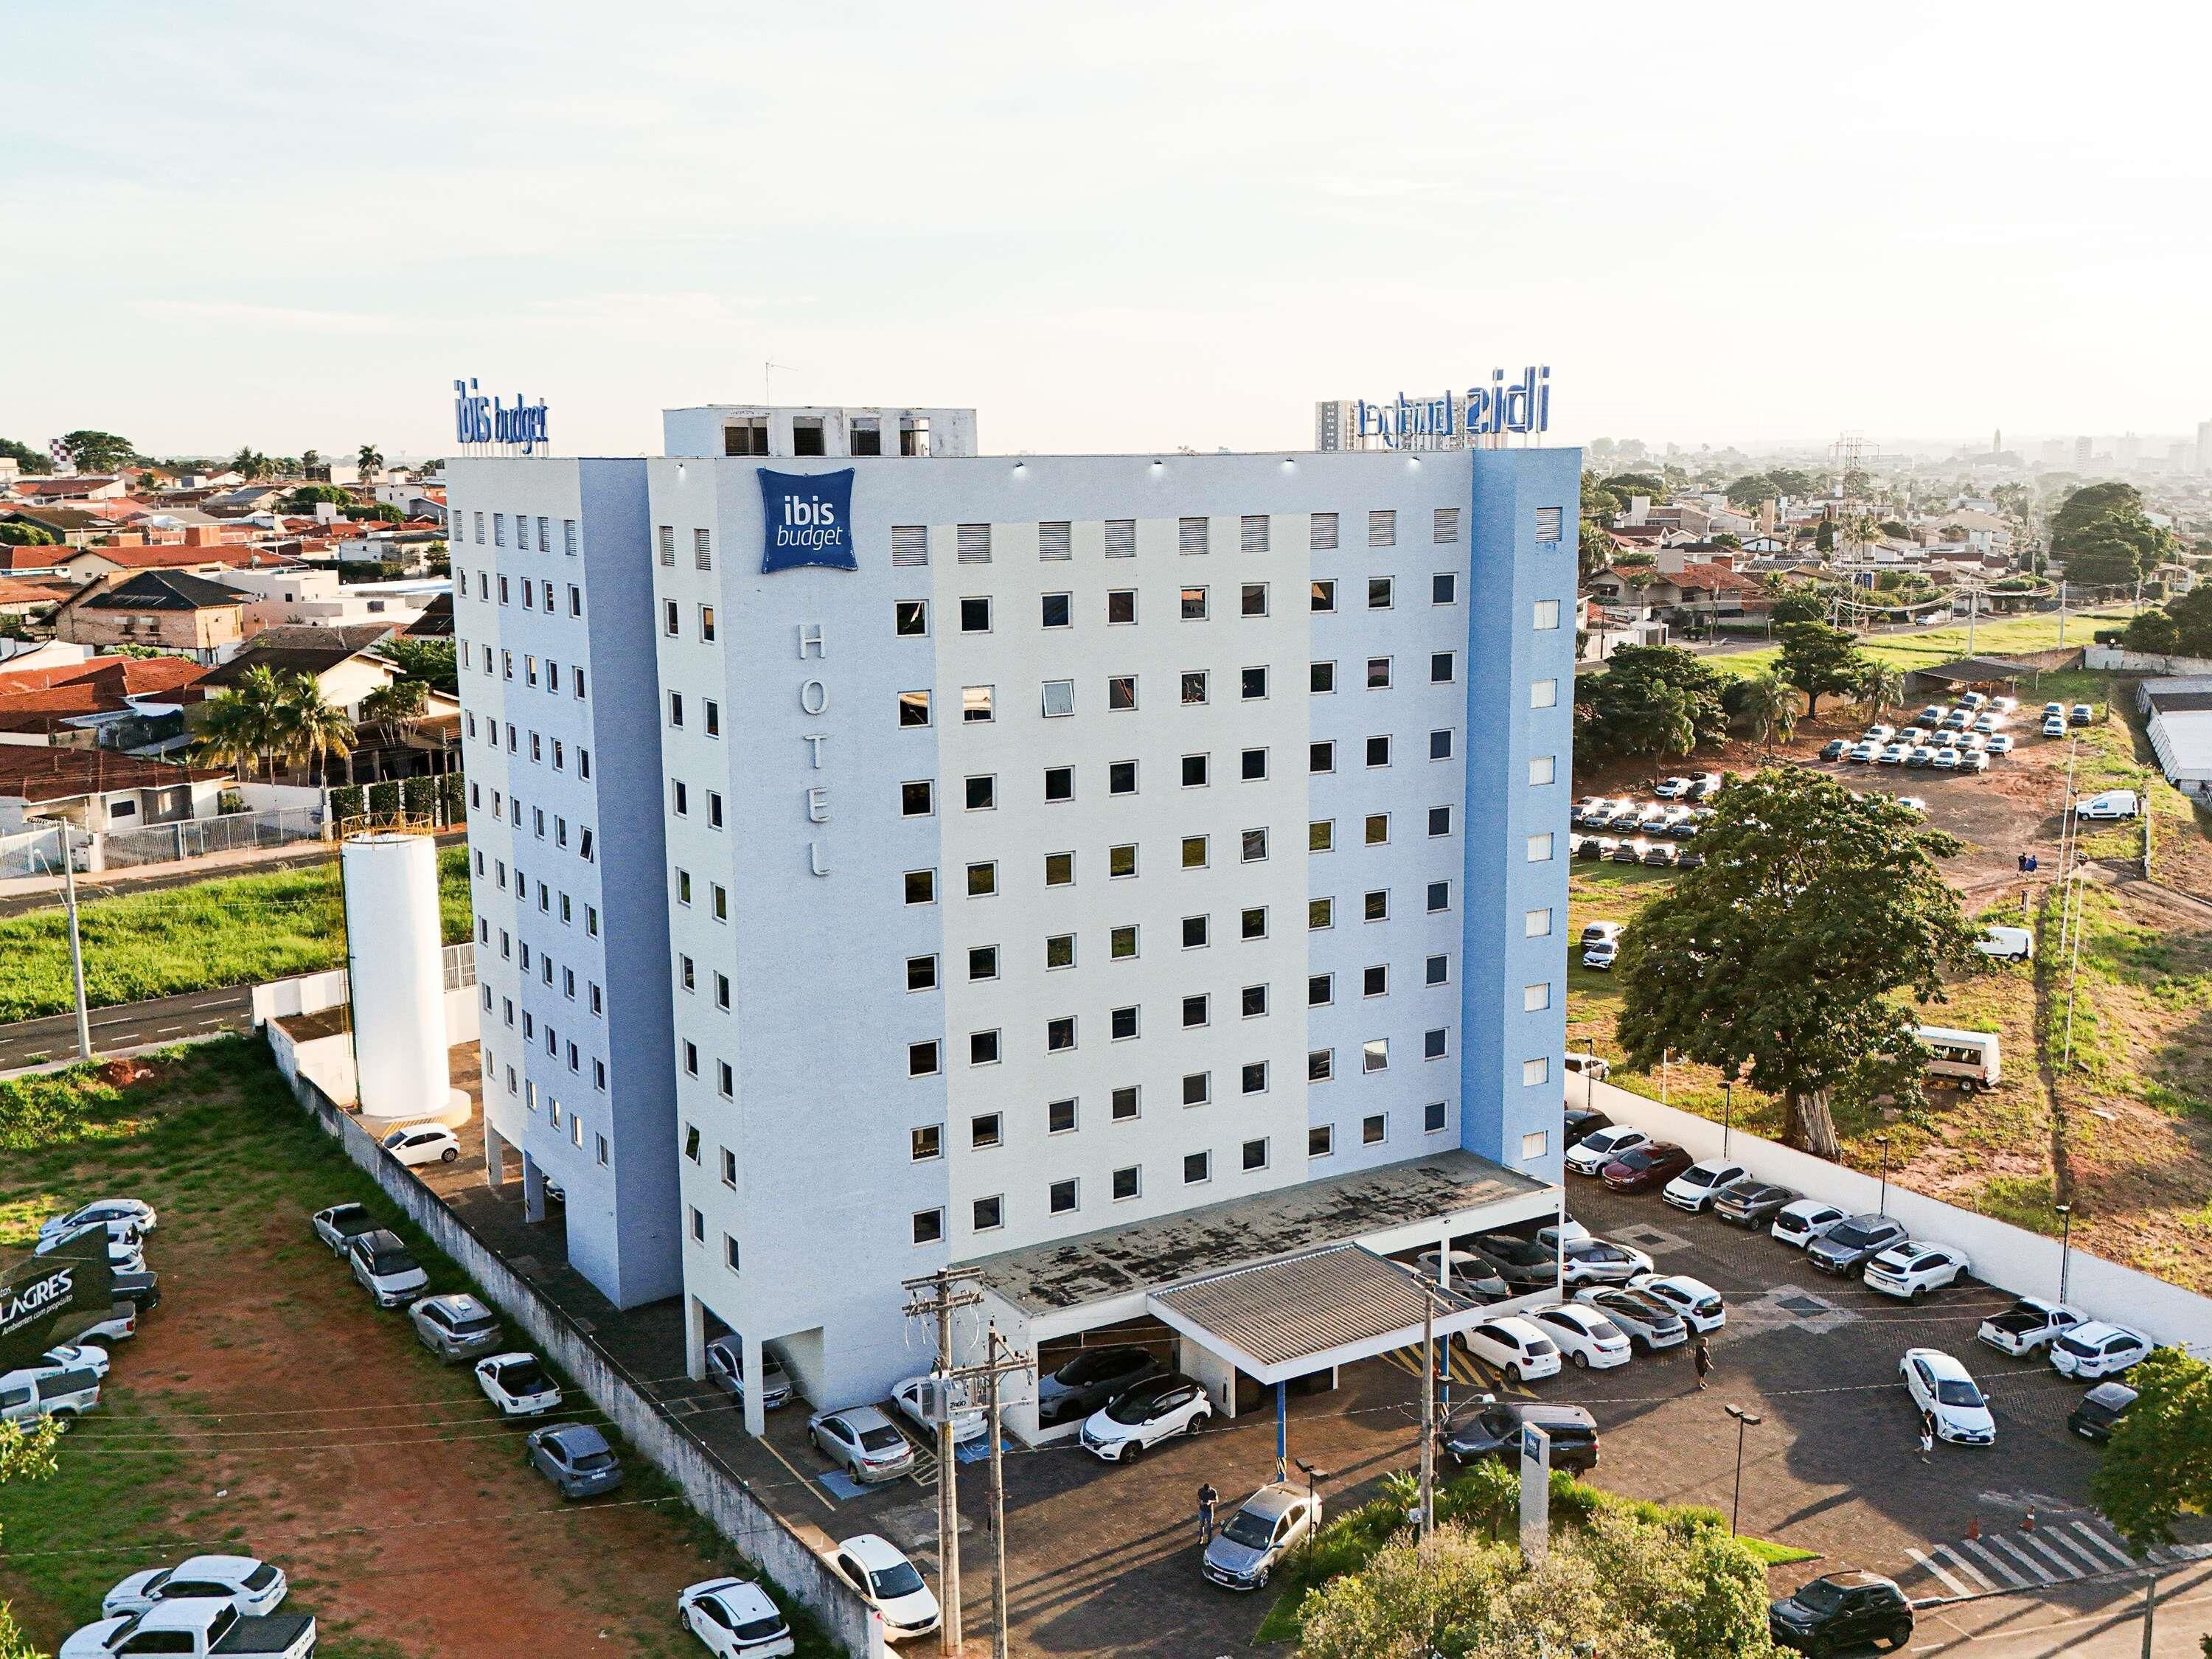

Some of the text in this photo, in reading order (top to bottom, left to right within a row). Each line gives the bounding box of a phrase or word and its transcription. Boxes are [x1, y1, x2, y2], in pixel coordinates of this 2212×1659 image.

[454, 378, 549, 454] ibis budget
[784, 495, 835, 526] ibis
[776, 524, 843, 551] budget
[798, 624, 832, 877] HOTEL
[33, 1308, 46, 1320] com
